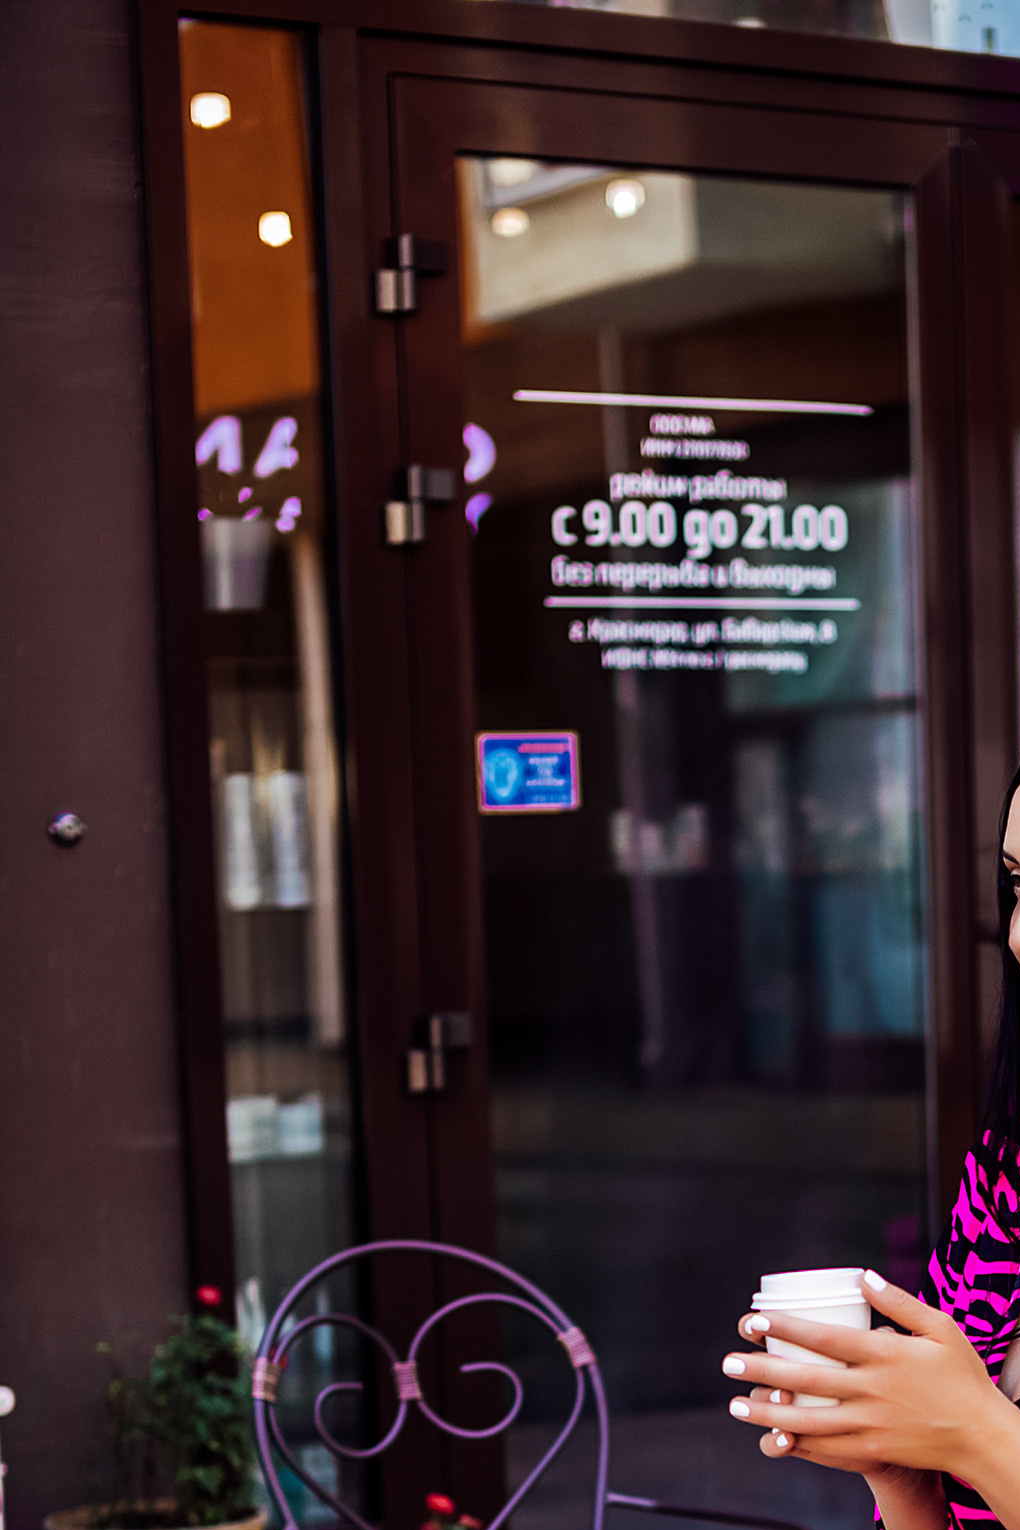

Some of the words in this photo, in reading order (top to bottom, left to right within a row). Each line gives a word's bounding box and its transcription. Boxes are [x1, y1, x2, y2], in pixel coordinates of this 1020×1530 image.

[689, 469, 787, 502] работы
[582, 499, 677, 548] 9.00
[741, 503, 848, 551] 21.00
